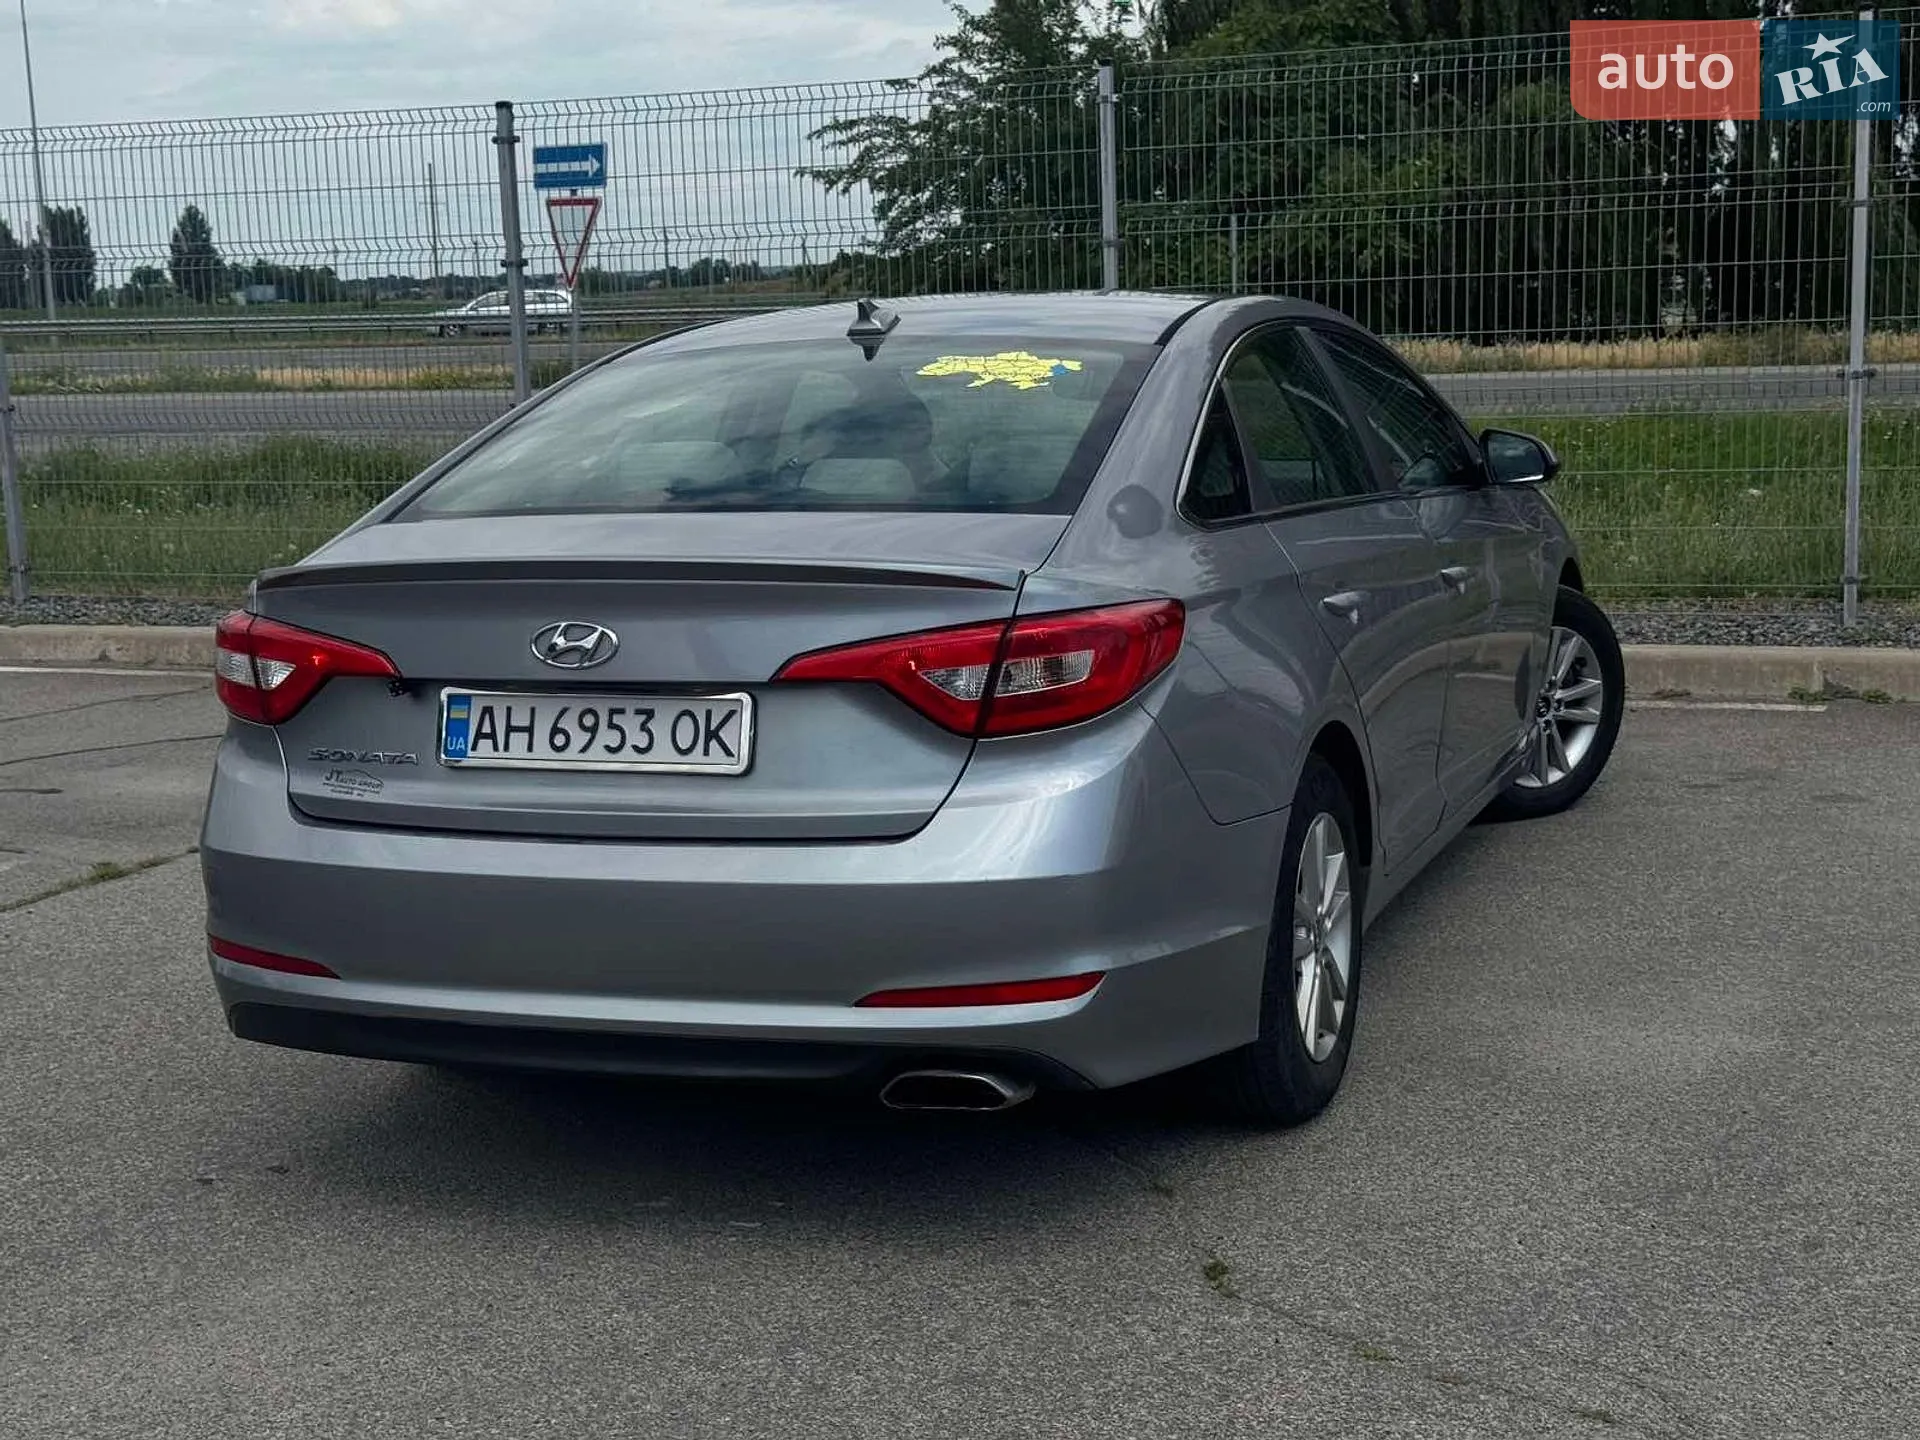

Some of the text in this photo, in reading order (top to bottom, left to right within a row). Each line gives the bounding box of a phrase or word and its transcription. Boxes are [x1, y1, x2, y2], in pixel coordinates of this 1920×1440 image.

[470, 705, 738, 757] AH 6953 OK
[447, 736, 465, 750] UA
[308, 747, 418, 765] SONATA
